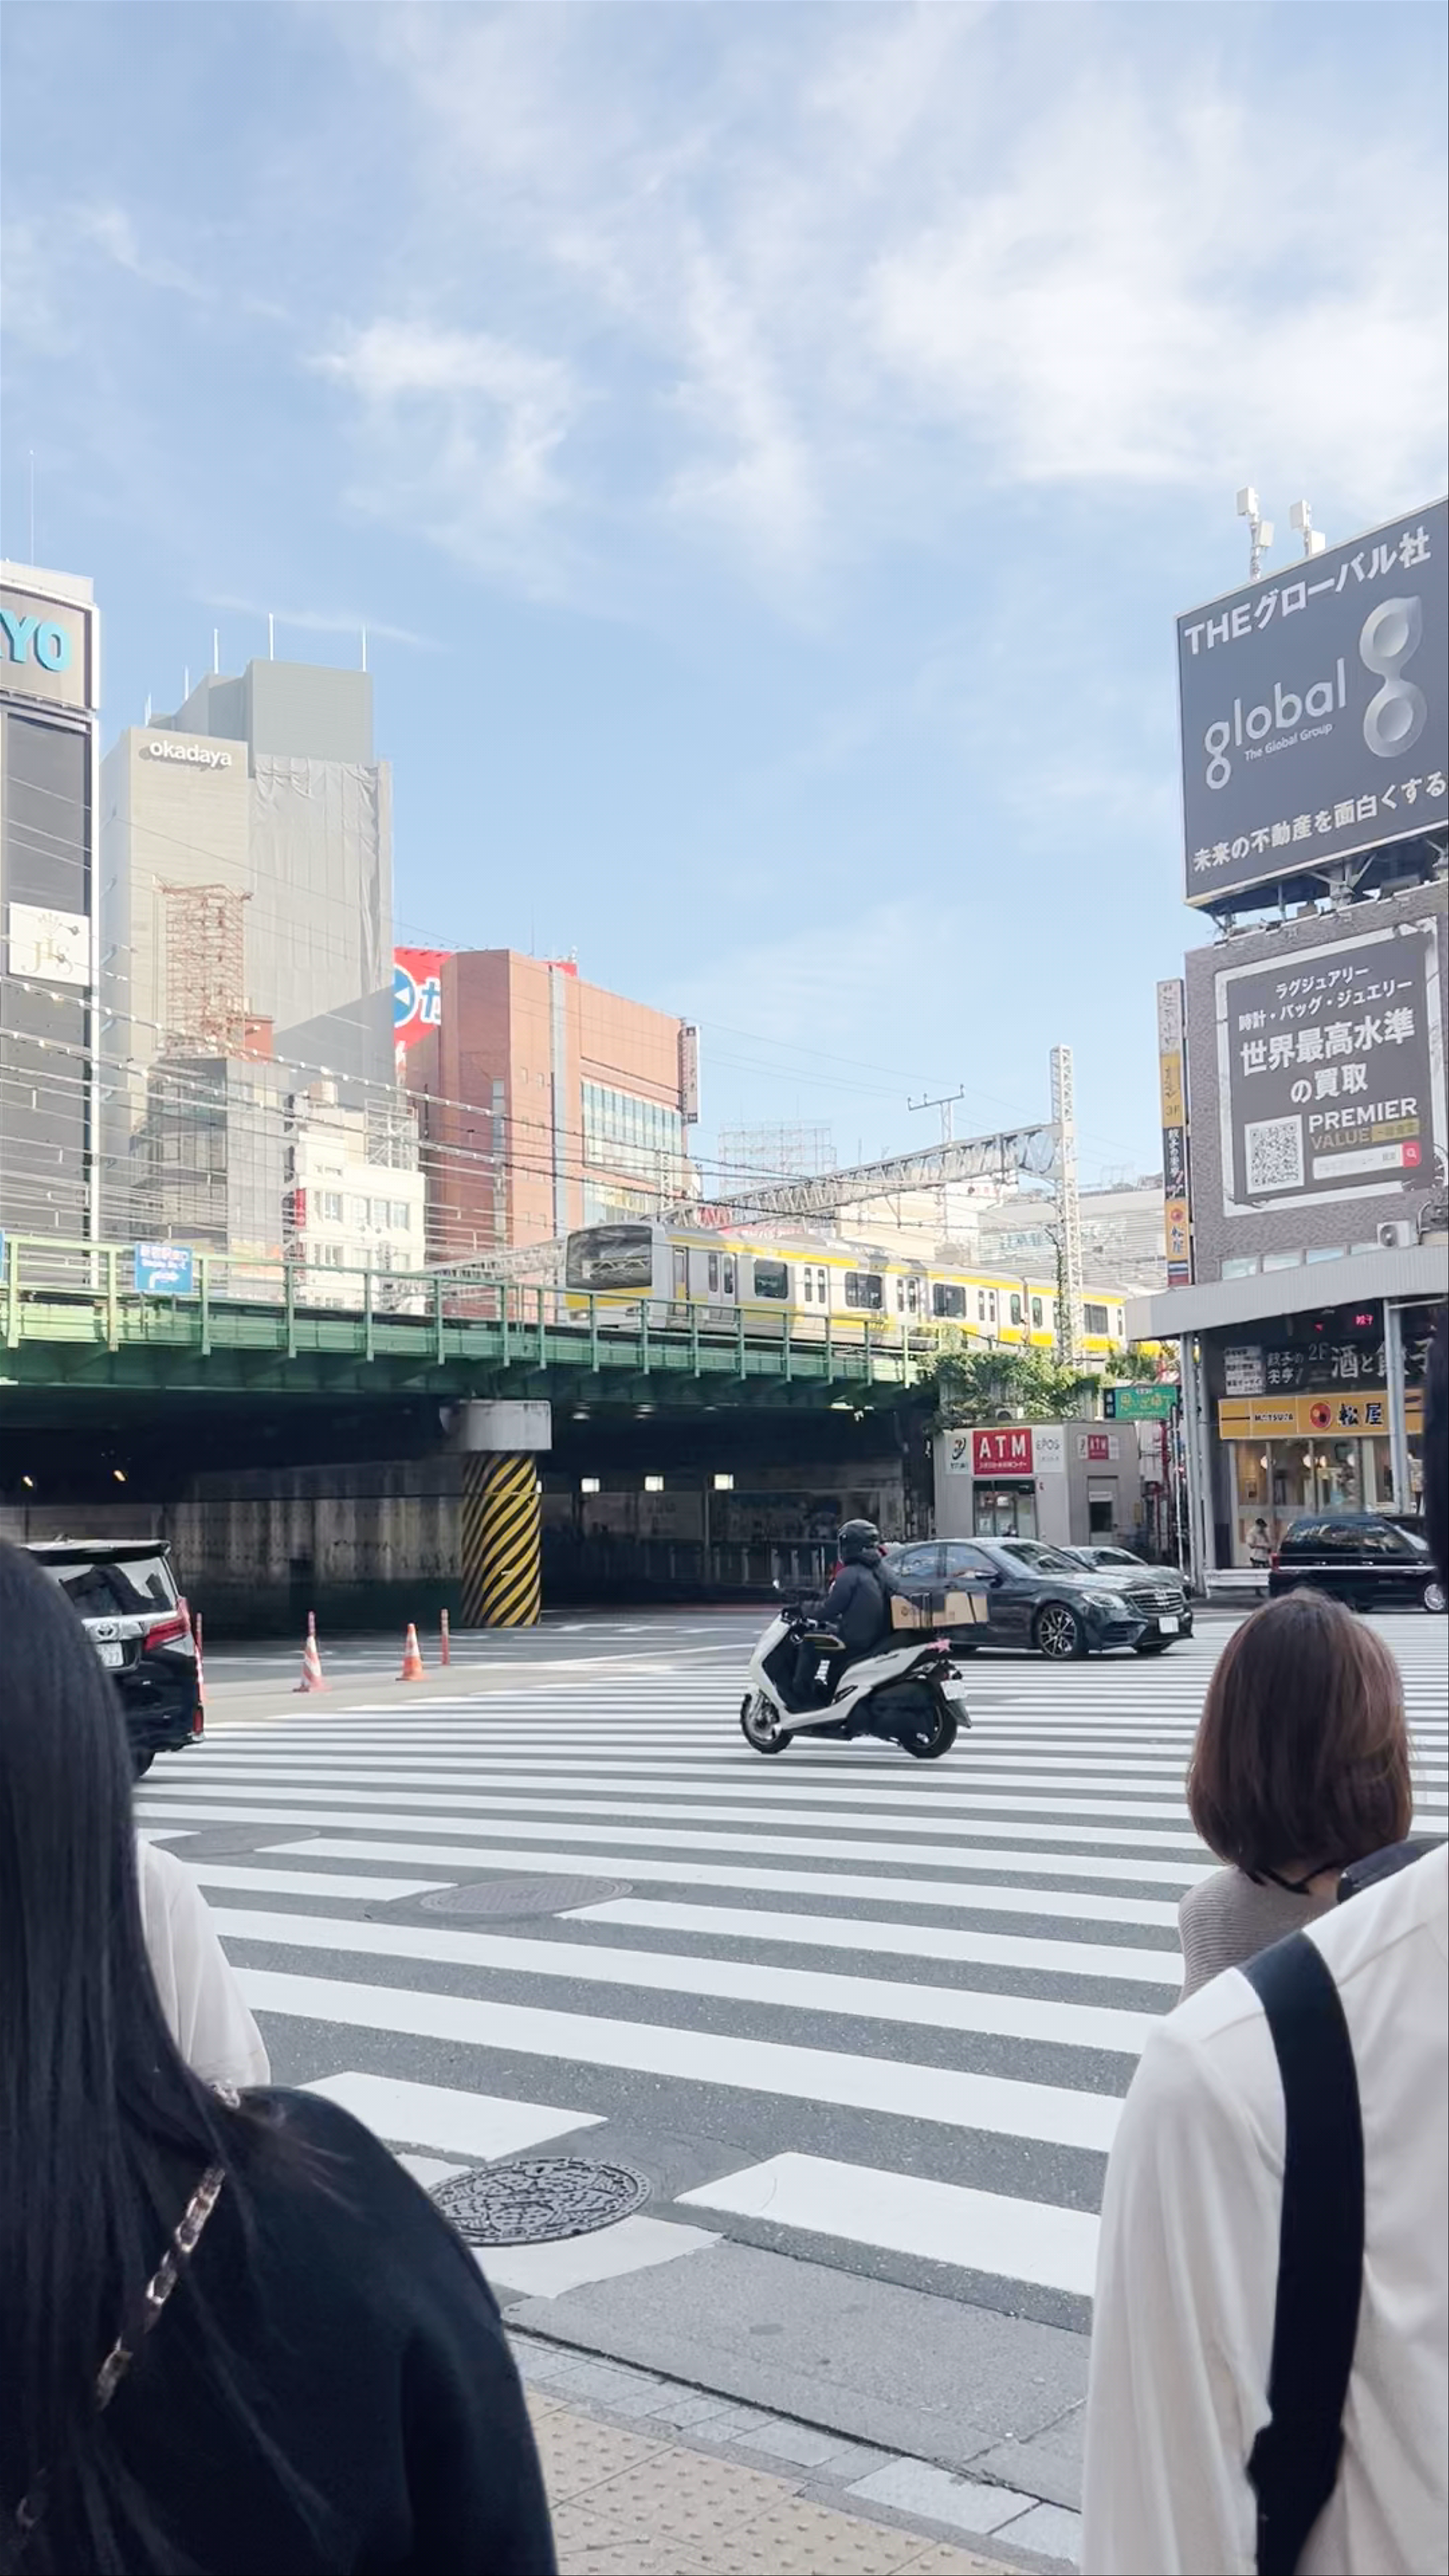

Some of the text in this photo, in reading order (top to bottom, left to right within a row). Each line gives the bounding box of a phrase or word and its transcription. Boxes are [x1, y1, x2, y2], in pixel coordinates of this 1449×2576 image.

[1184, 526, 1431, 655] THEグローバル社
[0, 609, 72, 672] YO
[1204, 657, 1346, 789] global
[149, 740, 232, 767] okadaya
[1244, 723, 1333, 761] The Global Group
[1193, 771, 1447, 872] 未来の不動産を面白くする
[1275, 966, 1370, 999] ラグジュアリー
[1238, 980, 1412, 1031] 時計・バッグ・ジュエリー
[1240, 1006, 1415, 1077] 世界最高水準
[1291, 1063, 1368, 1103] の買取
[1309, 1097, 1417, 1133] PREMIER
[1311, 1127, 1370, 1150] VALUE
[1308, 1342, 1329, 1360] 2F
[1338, 1402, 1384, 1426] 松屋
[980, 1434, 1026, 1458] ATM
[1036, 1438, 1060, 1450] EPOS
